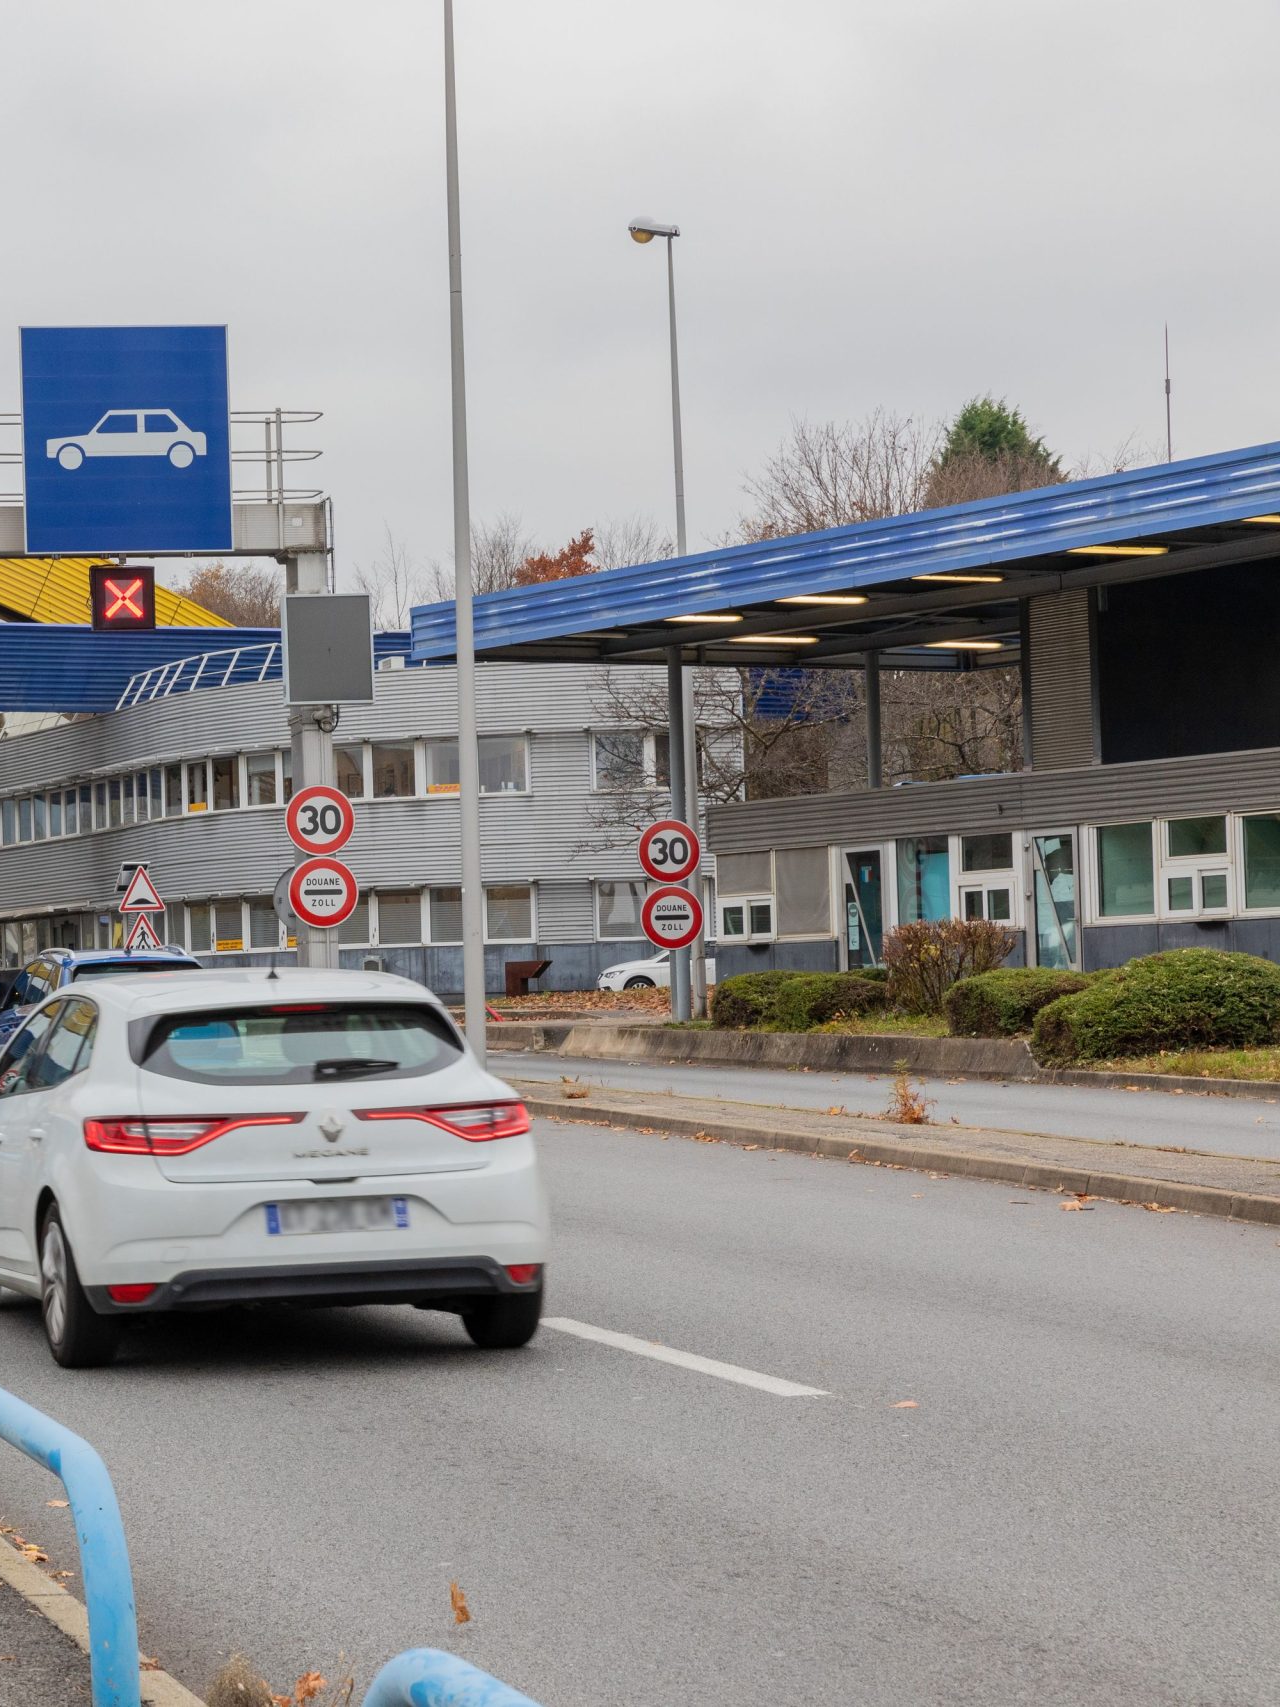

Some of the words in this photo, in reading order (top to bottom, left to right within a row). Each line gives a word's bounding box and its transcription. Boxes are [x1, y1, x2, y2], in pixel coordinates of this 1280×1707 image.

[300, 804, 342, 836] 30
[651, 837, 689, 866] 30
[306, 877, 341, 886] DOUANE
[311, 898, 336, 907] ZOLL
[656, 904, 688, 912] DOUANE
[661, 923, 684, 931] ZOLL
